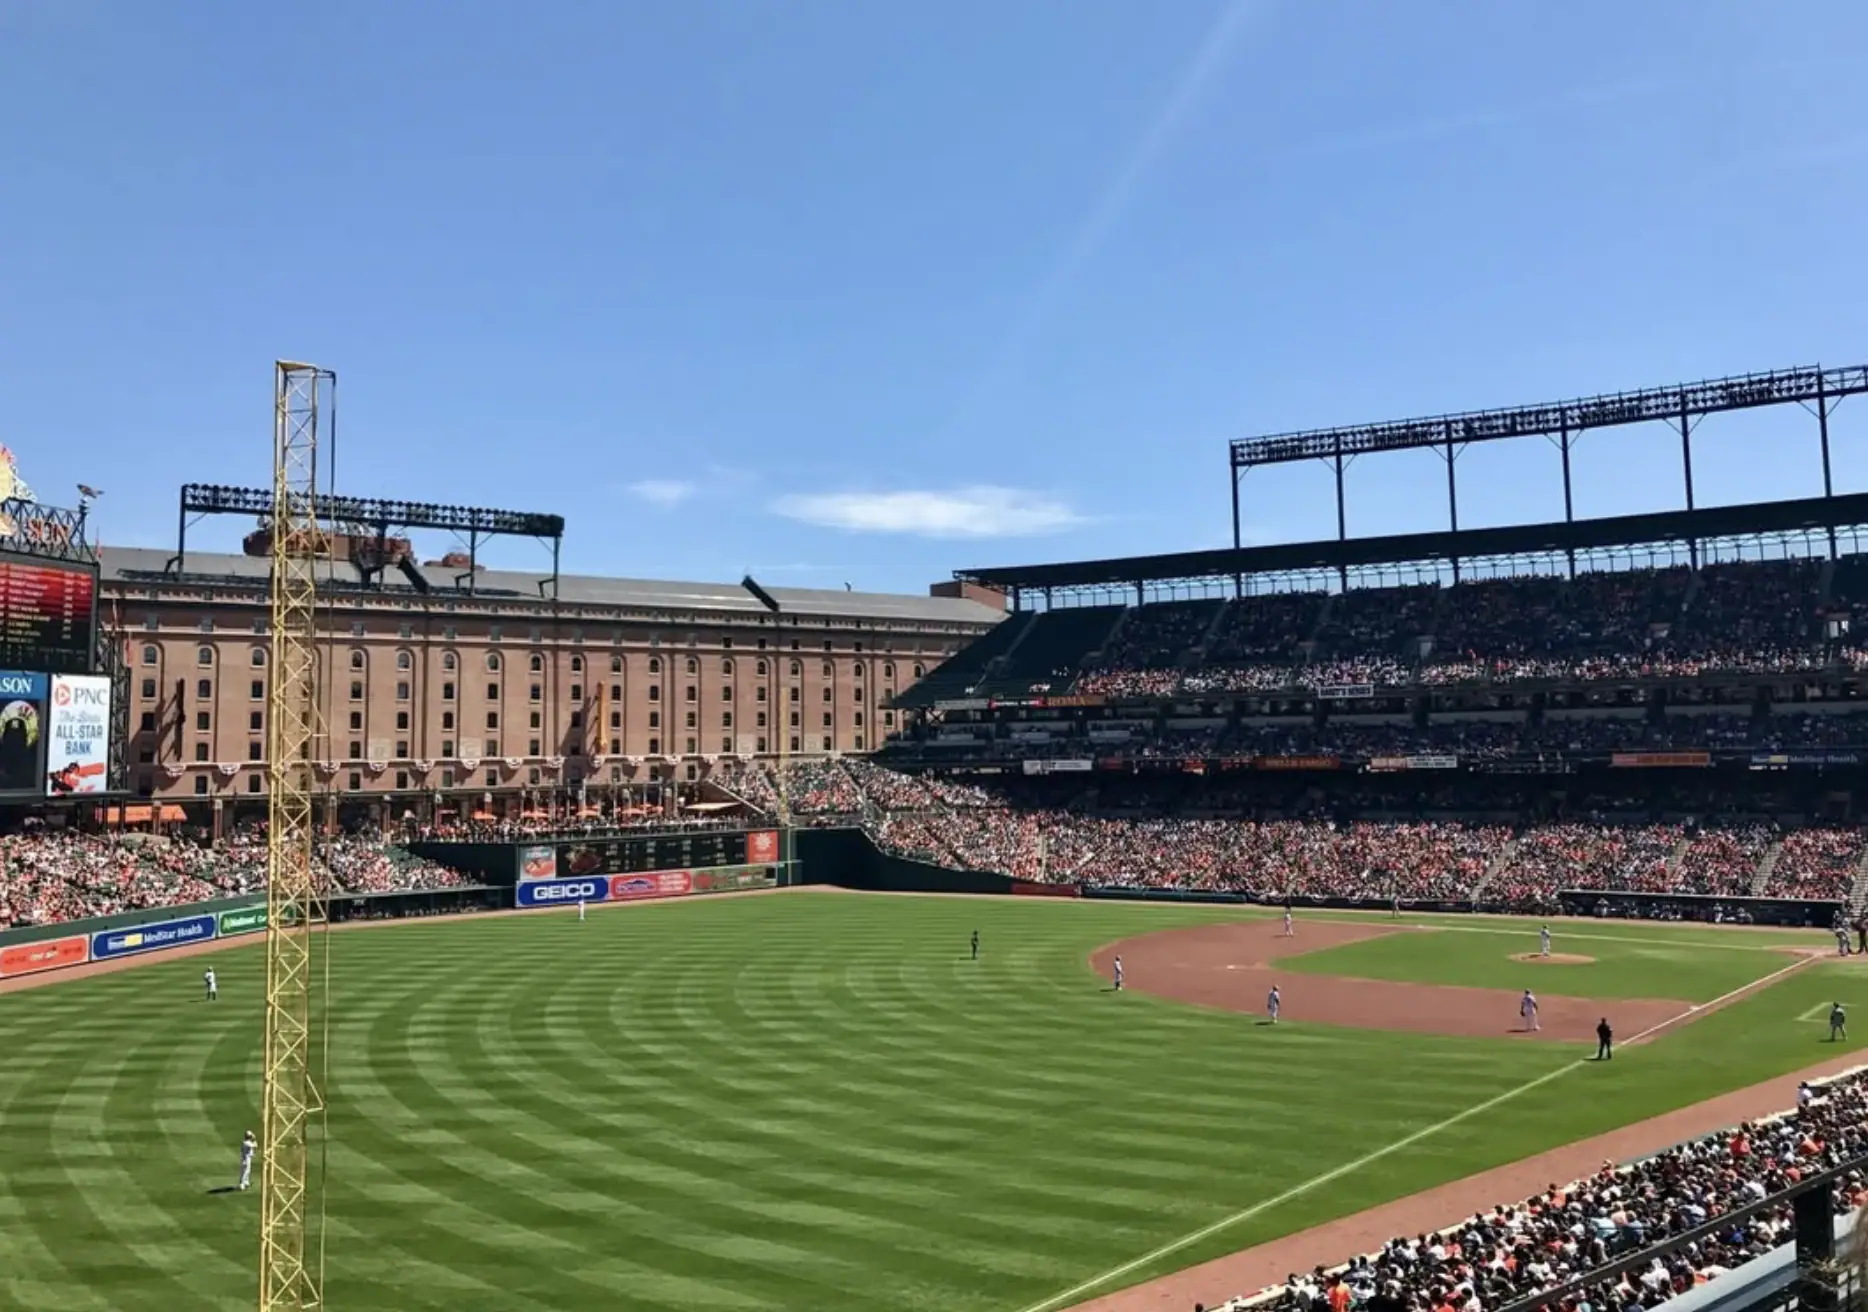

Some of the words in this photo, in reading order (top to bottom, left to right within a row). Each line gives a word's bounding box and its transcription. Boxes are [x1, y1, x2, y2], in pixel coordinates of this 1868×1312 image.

[74, 687, 108, 706] PNC
[55, 724, 104, 740] ALL-STAR
[64, 740, 93, 756] BANK
[533, 882, 595, 900] GEICO
[144, 929, 176, 943] MedStar
[177, 923, 204, 937] Health
